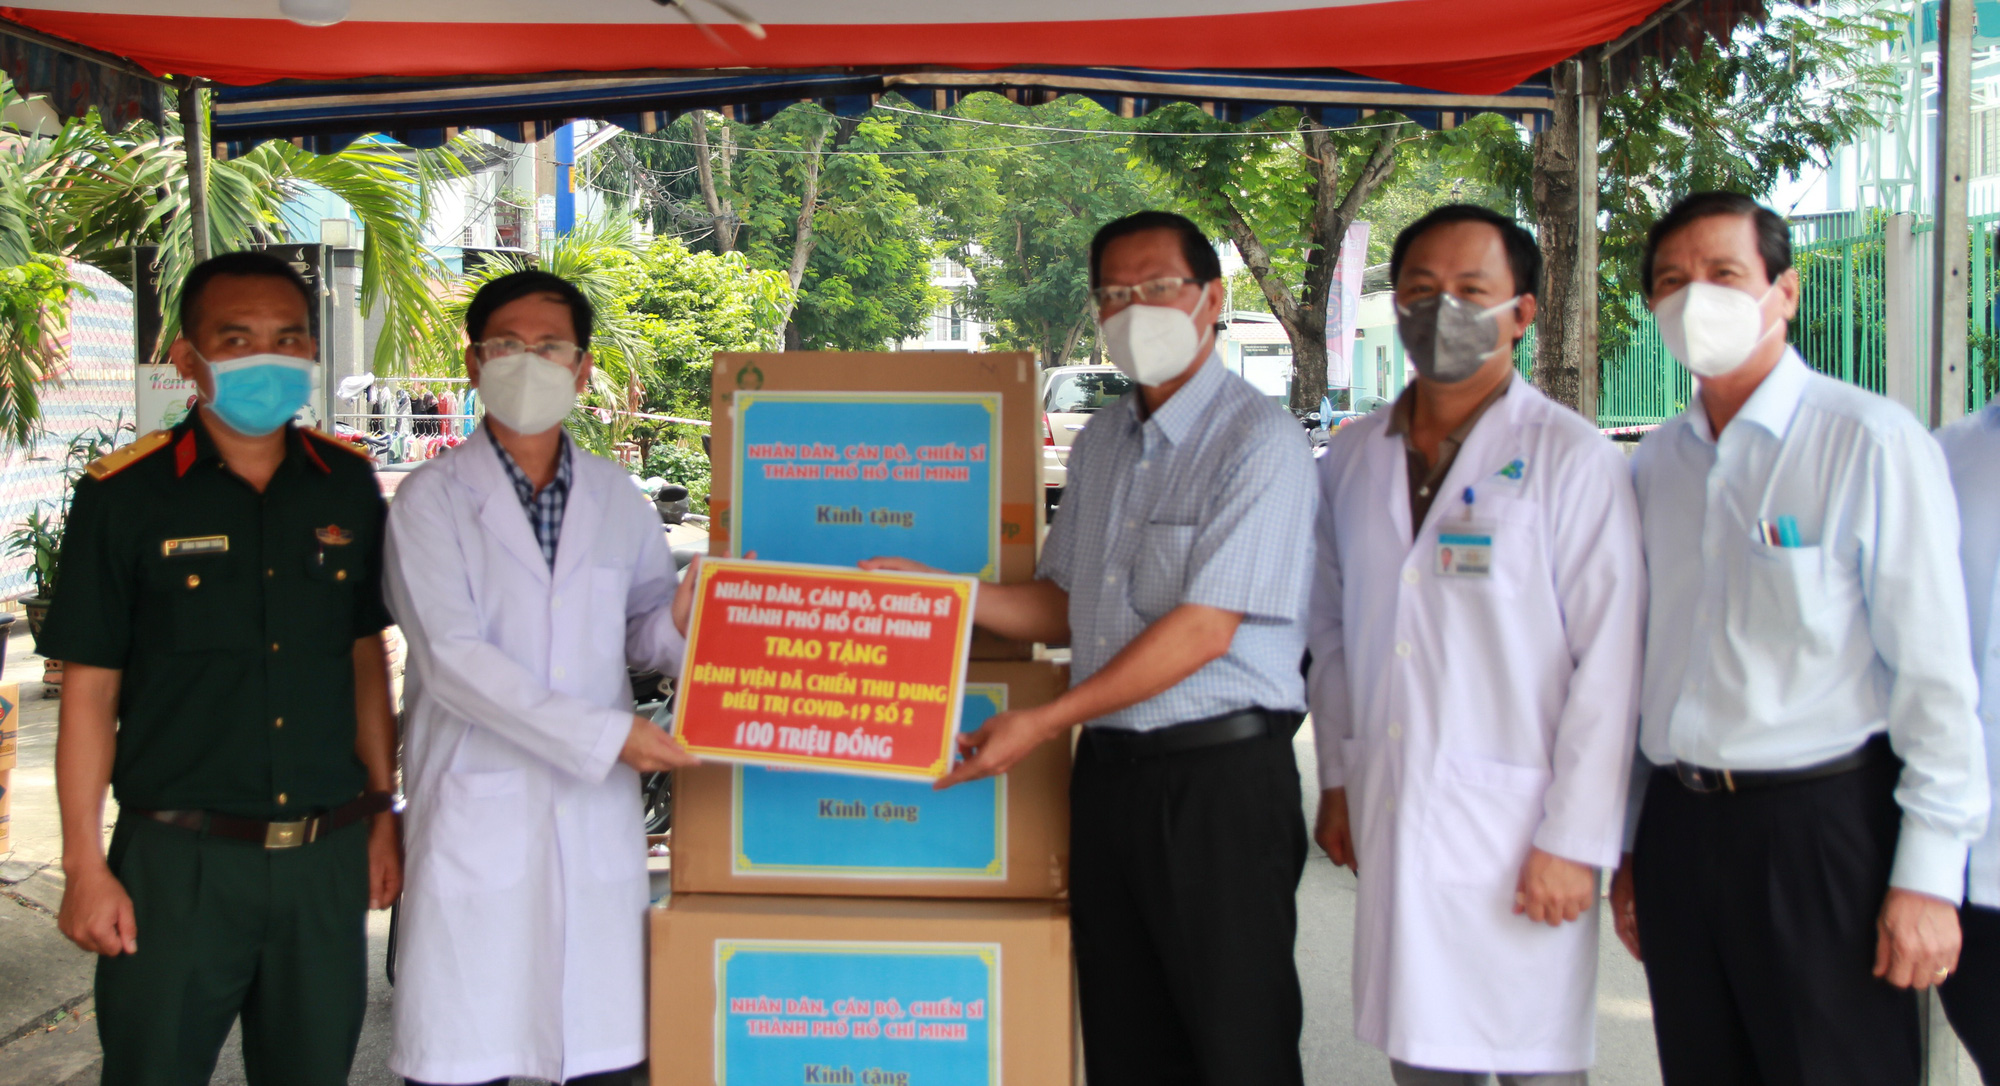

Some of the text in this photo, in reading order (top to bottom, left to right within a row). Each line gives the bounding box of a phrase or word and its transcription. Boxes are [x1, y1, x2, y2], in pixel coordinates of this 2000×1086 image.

[748, 442, 797, 459] NHÂN
[844, 443, 879, 460] CÁN
[916, 442, 966, 461] CHIẾN
[969, 443, 986, 461] SĨ
[763, 461, 820, 479] THÀNH
[824, 461, 859, 479] PHỐ
[892, 462, 921, 480] CHÍ
[924, 466, 969, 481] MINH
[815, 505, 915, 528] Kính tặng
[715, 580, 764, 601] NHÂN
[808, 586, 845, 607] CÁN
[880, 592, 931, 615] CHIẾN
[727, 604, 783, 626] THÀNH
[785, 607, 821, 628] PHỐ
[853, 614, 884, 635] CHÍ
[885, 618, 932, 639] MINH
[766, 636, 887, 666] TRAO TẶNG
[693, 662, 737, 685] BỆNH
[740, 666, 777, 690] VIỆN
[806, 671, 857, 695] CHIẾN
[861, 678, 895, 699] THU
[763, 695, 789, 717] TRỊ
[792, 697, 871, 721] COVID-19
[875, 701, 899, 723] SỐ
[902, 707, 914, 726] 2
[735, 720, 775, 748] 100
[778, 724, 832, 756] TRIỆU
[818, 799, 919, 822] Kính tặng
[731, 995, 782, 1014] NHÂN
[833, 997, 870, 1016] CÁN
[910, 997, 962, 1018] CHIẾN
[966, 999, 984, 1019] SĨ
[746, 1016, 808, 1036] THÀNH
[811, 1017, 849, 1037] PHỐ
[884, 1019, 915, 1039] CHÍ
[919, 1022, 967, 1040] MINH
[804, 1064, 855, 1084] Kính
